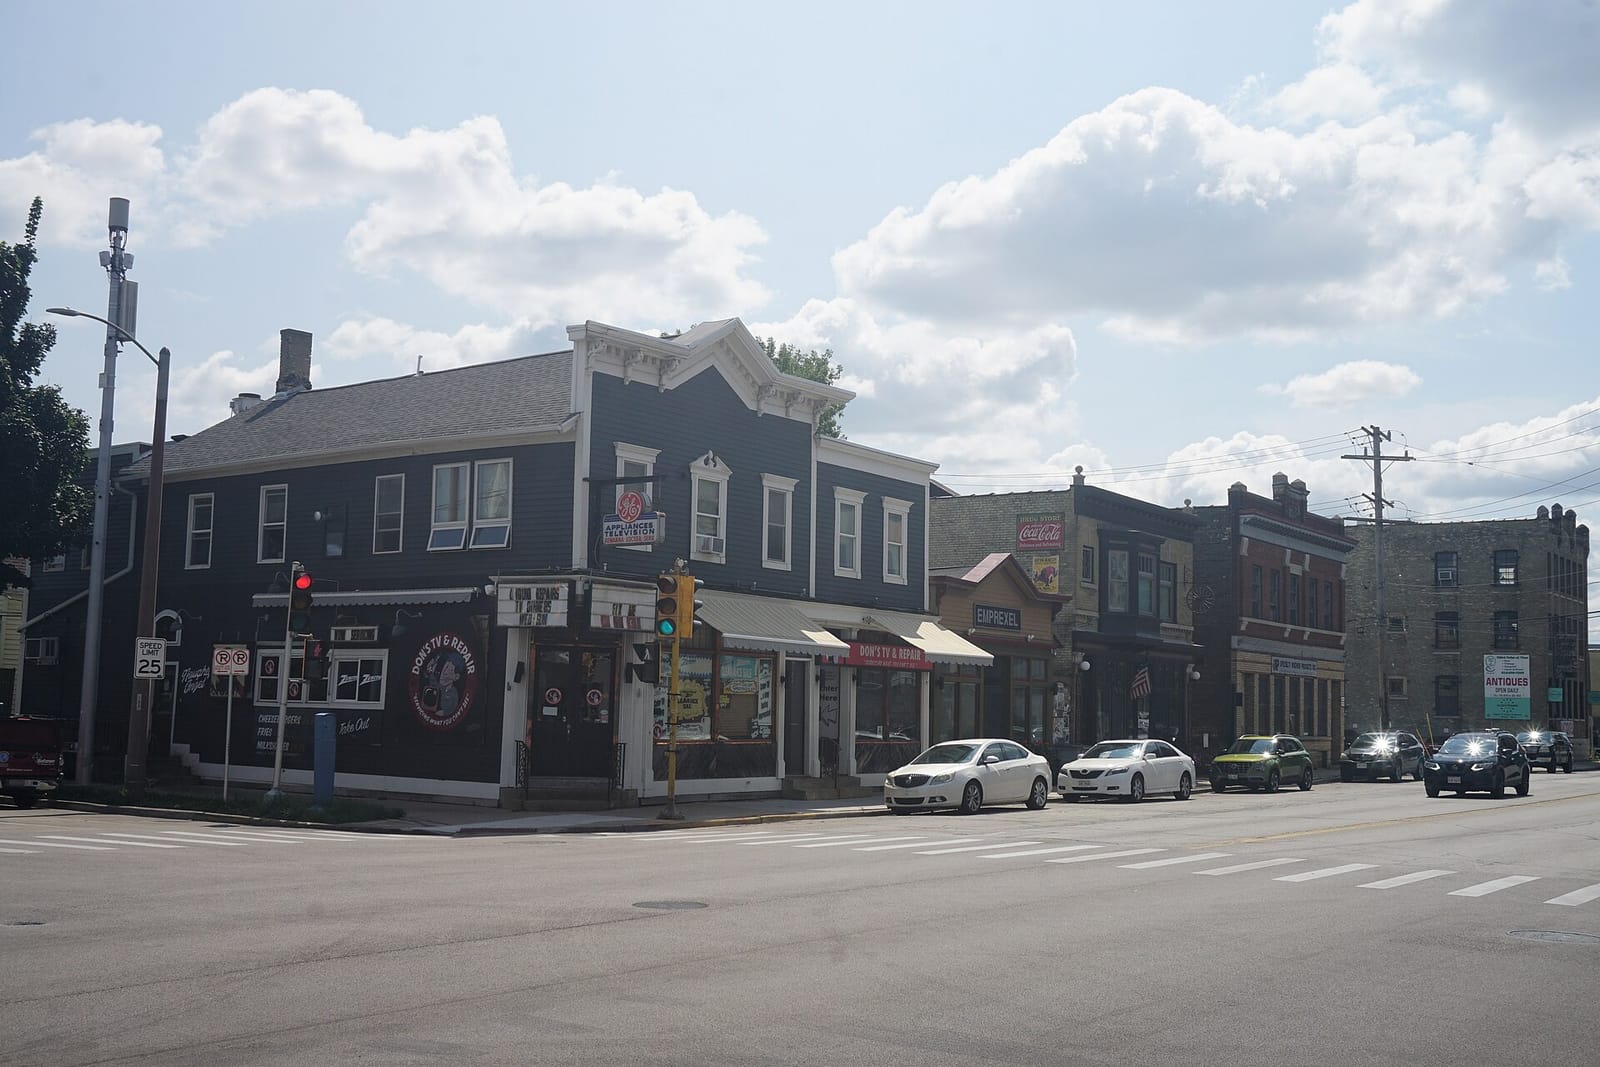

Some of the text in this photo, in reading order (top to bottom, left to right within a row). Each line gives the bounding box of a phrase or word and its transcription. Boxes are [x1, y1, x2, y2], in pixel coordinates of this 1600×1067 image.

[604, 528, 655, 537] TELEVISION
[605, 522, 653, 531] APPLIANCES
[977, 608, 1019, 627] EMPREXEL
[140, 642, 162, 650] SPEED
[411, 634, 476, 675] DON'S TV & REPAIR
[859, 644, 921, 661] DON'S TV & REPAIR
[138, 659, 161, 674] 25
[1486, 677, 1529, 687] ANTIQUES
[257, 727, 273, 737] FRIES
[338, 716, 370, 736] Take Out
